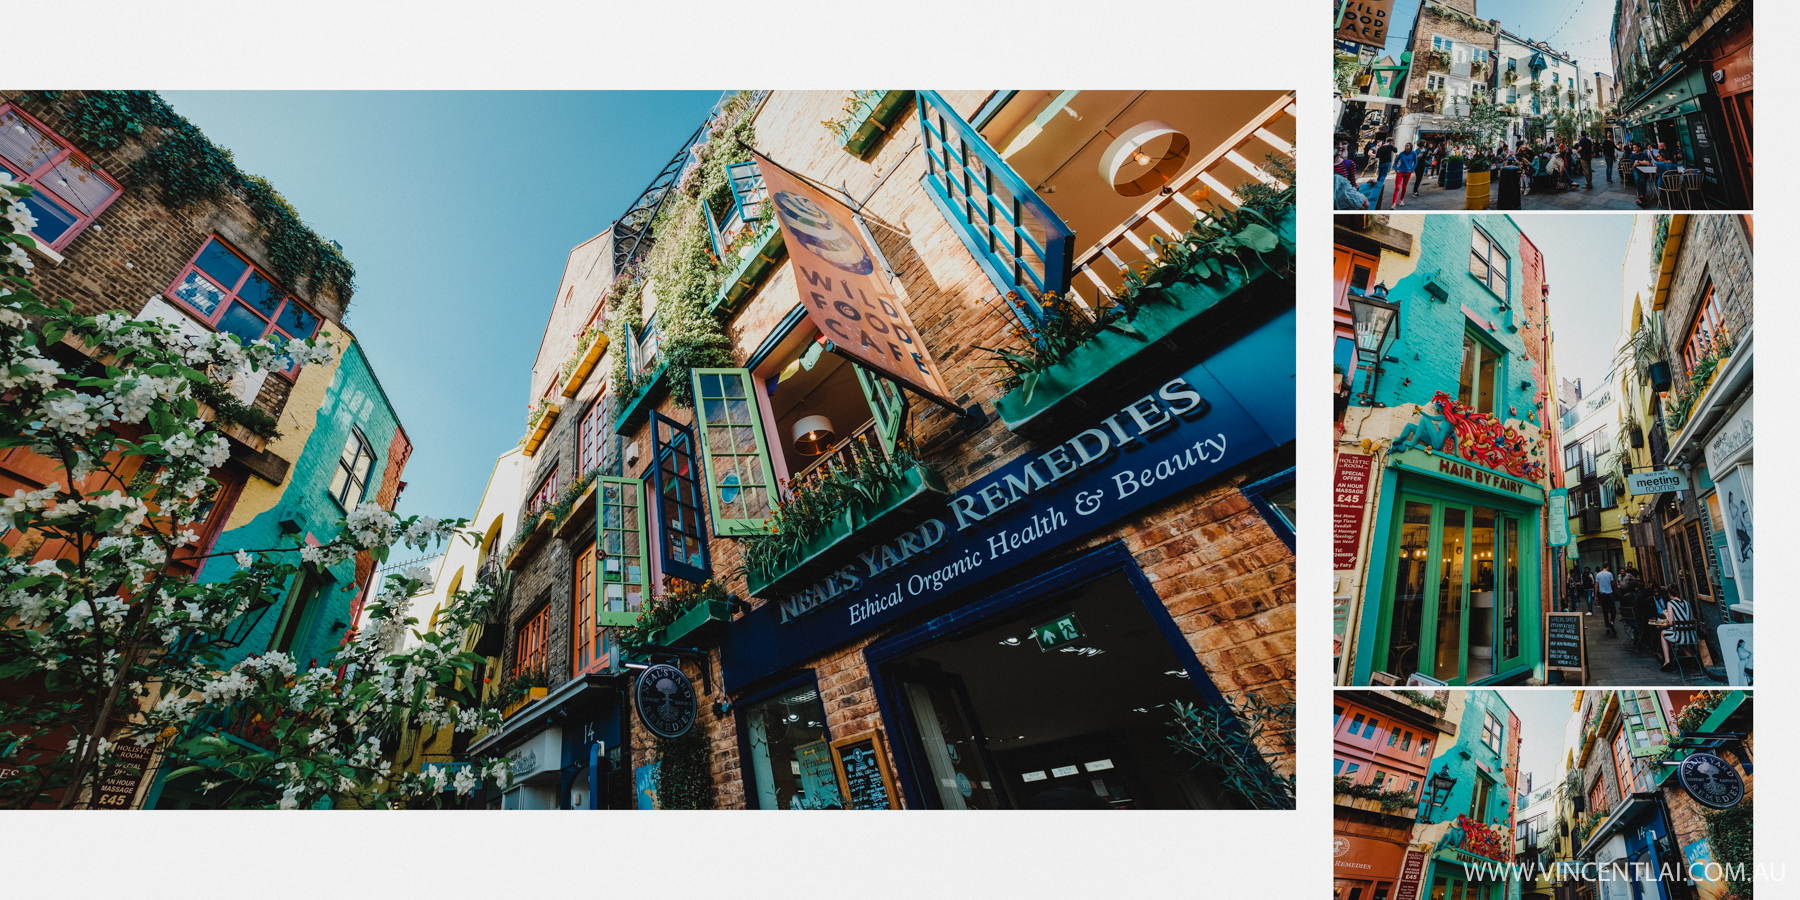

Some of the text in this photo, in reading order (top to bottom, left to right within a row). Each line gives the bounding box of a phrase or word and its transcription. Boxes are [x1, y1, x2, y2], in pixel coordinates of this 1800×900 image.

[799, 265, 899, 318] WILD
[810, 291, 913, 344] FOOD
[1440, 459, 1523, 494] HAIR BY FAIRY
[1637, 476, 1680, 487] meeting
[1645, 483, 1675, 492] rooms
[777, 377, 1203, 625] NEAL'S YARD REMEDIES
[1337, 494, 1359, 503] £45
[848, 432, 1228, 626] Ethical Organic Health & Beauty
[643, 669, 691, 698] NEAL'S YARD
[645, 705, 691, 732] REMEDIES
[584, 722, 595, 744] 14
[117, 744, 152, 754] HOLISTIC
[120, 752, 143, 760] ROOM
[1686, 756, 1734, 777] NEAL'S YARD
[100, 785, 134, 794] MASSAGE
[1692, 784, 1739, 803] REMEDIES
[99, 794, 126, 805] £45
[1335, 860, 1371, 870] REMEDIES
[1456, 853, 1475, 864] HAIR
